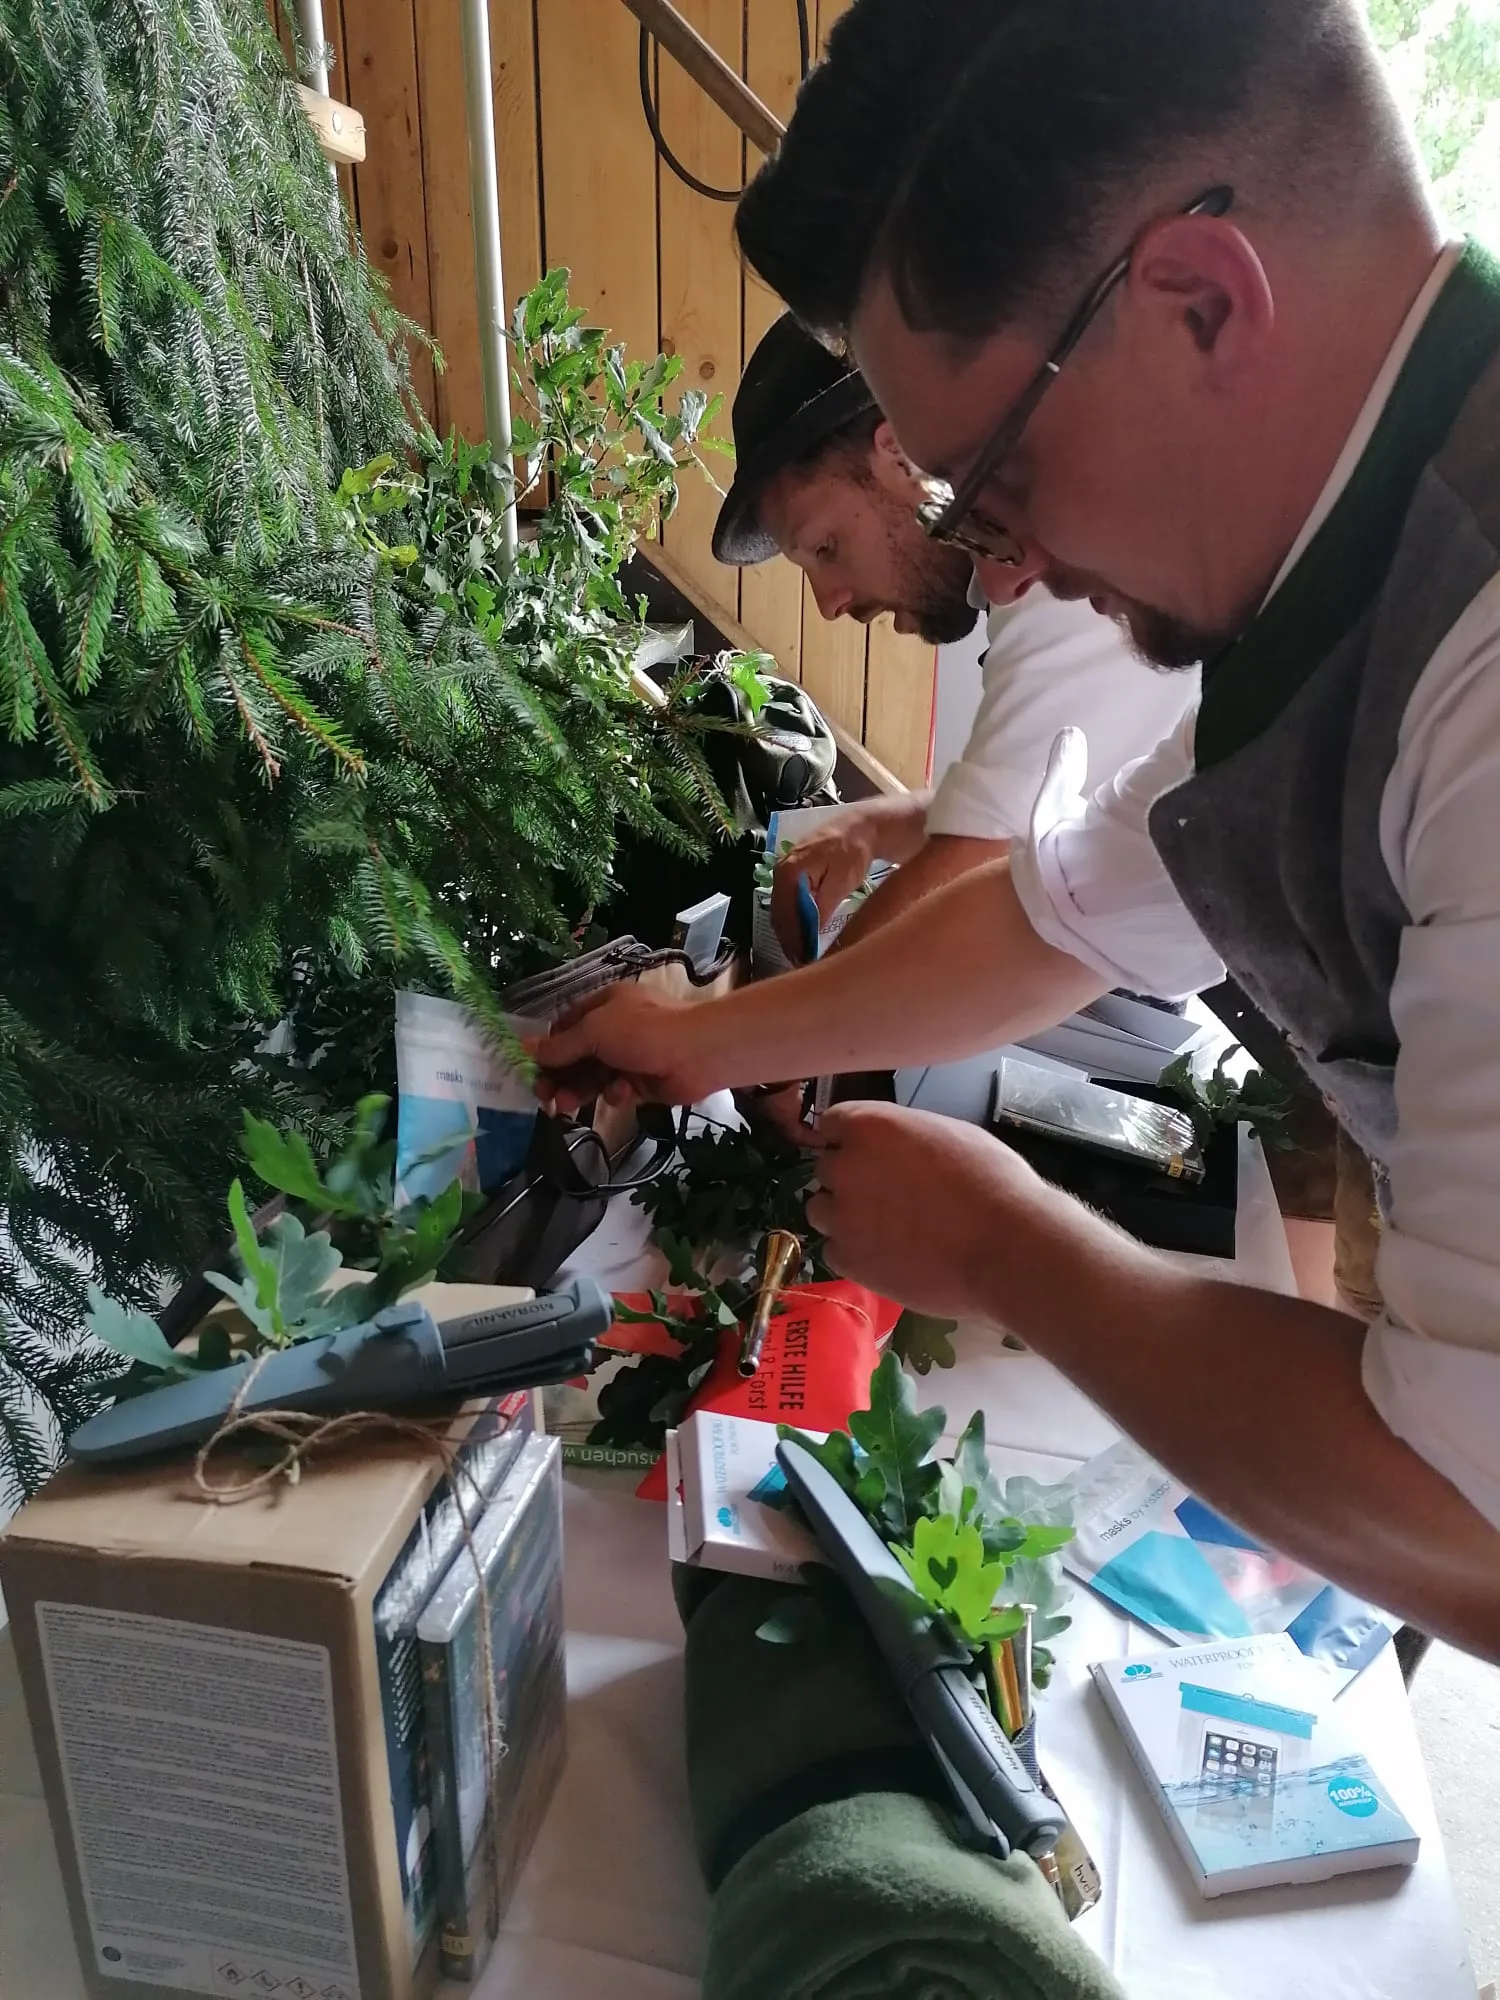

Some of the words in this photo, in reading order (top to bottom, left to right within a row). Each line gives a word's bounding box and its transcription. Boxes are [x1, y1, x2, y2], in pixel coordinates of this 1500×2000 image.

[783, 1318, 810, 1358] ERSTE
[748, 1371, 774, 1410] Forst
[779, 1364, 806, 1410] HILFE
[1099, 1517, 1132, 1542] masks
[1129, 1507, 1145, 1521] by
[1168, 1646, 1255, 1669] WATERPROOF
[1329, 1785, 1374, 1802] 100%
[1074, 1864, 1096, 1894] hvd
